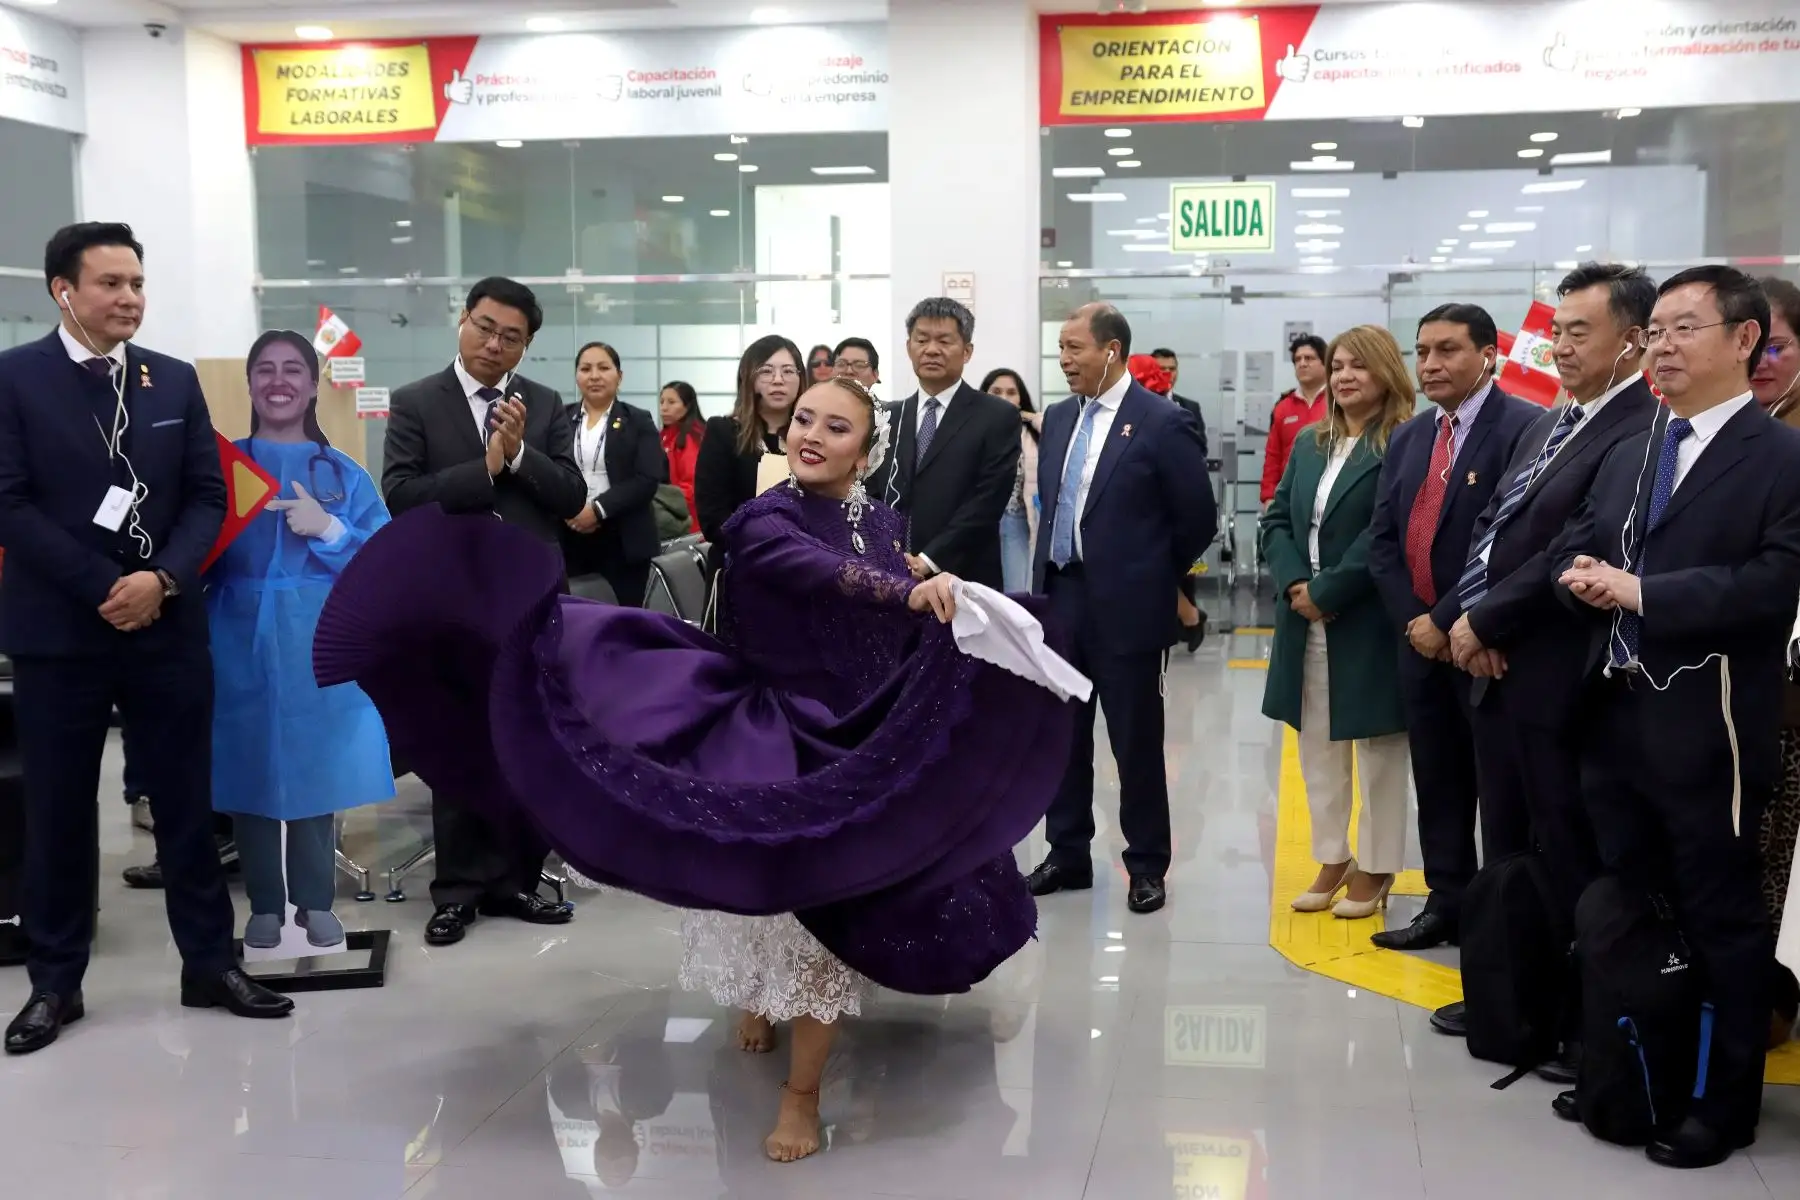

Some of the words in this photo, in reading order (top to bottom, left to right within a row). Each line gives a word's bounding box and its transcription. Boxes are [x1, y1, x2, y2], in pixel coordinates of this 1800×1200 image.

[1700, 17, 1797, 36] orientación
[1758, 38, 1780, 52] de
[1783, 38, 1800, 51] tu
[1314, 48, 1367, 62] Cursos
[275, 61, 410, 80] MODALDES
[627, 65, 717, 85] Capacitación
[1119, 64, 1174, 81] PARA
[1179, 64, 1203, 79] EL
[286, 85, 402, 103] FORMATIVAS
[627, 85, 674, 100] laboral
[675, 84, 722, 103] juvenil
[1070, 86, 1255, 107] EMPRENDIMIENTO
[290, 108, 399, 126] LABORALES
[1180, 198, 1263, 238] SALIDA
